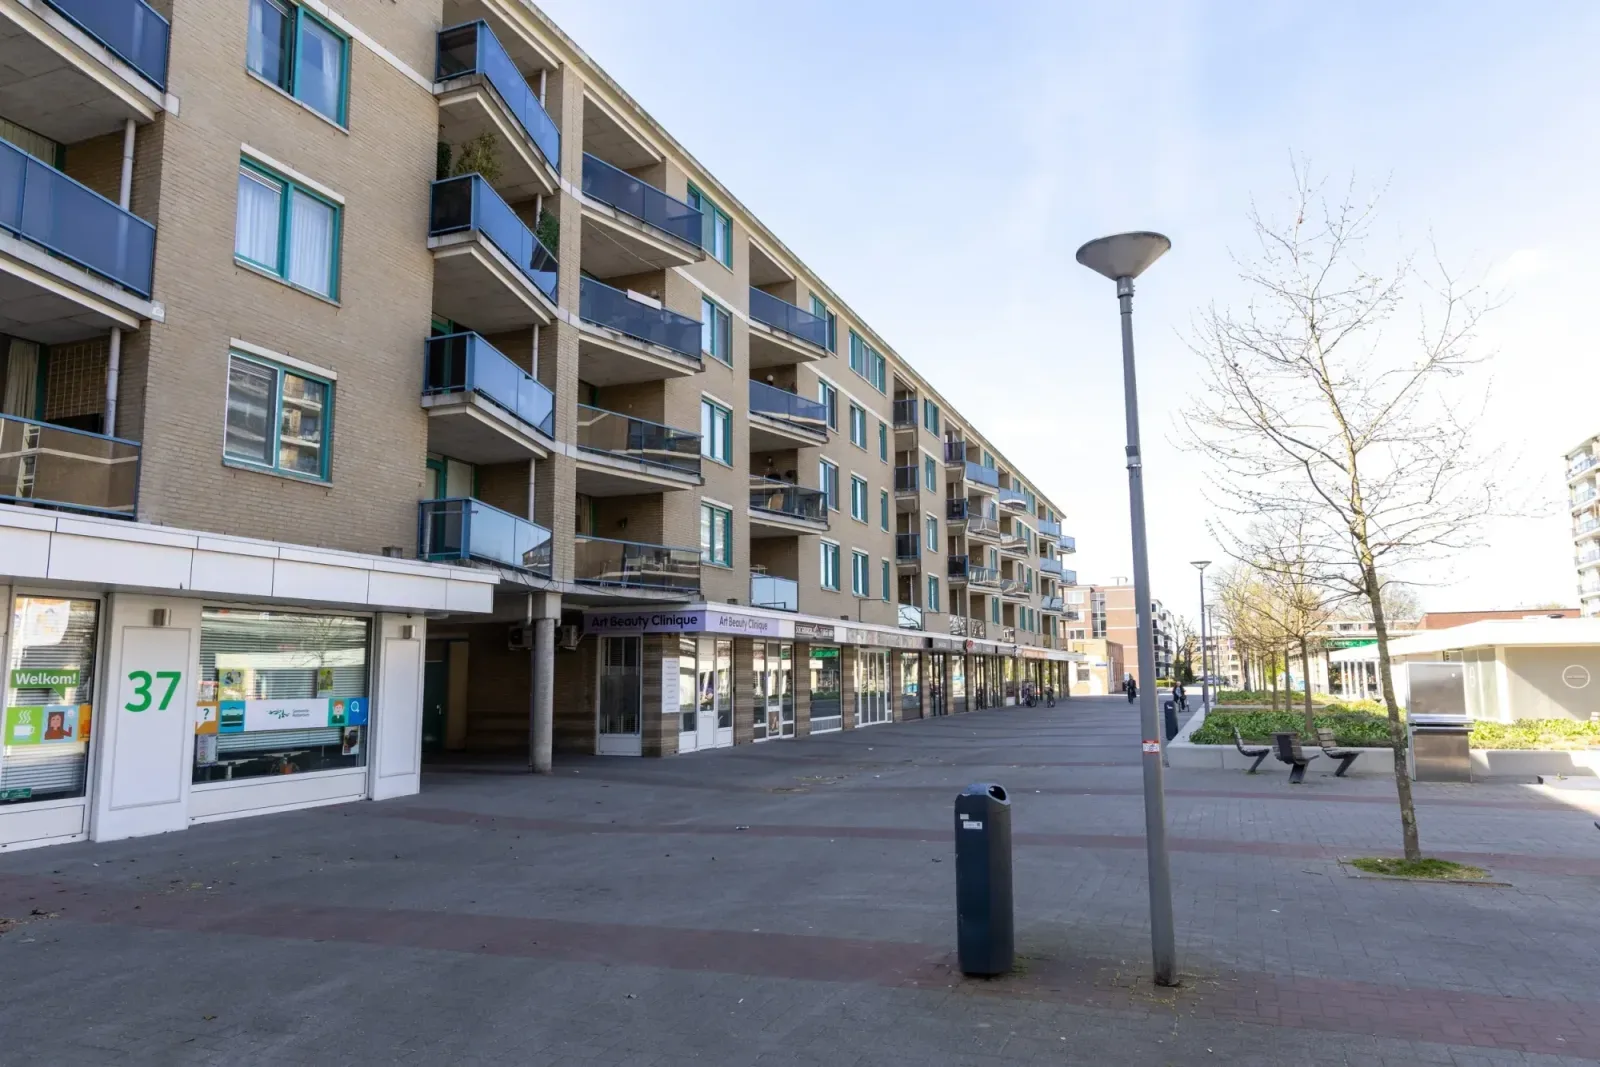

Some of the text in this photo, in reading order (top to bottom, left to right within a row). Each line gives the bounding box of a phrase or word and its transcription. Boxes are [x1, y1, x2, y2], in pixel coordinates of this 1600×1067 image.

[592, 614, 698, 630] Art Beauty Clinique
[719, 616, 768, 633] Art Beauty Clinique
[15, 672, 77, 685] Welkom!
[124, 670, 182, 713] 37
